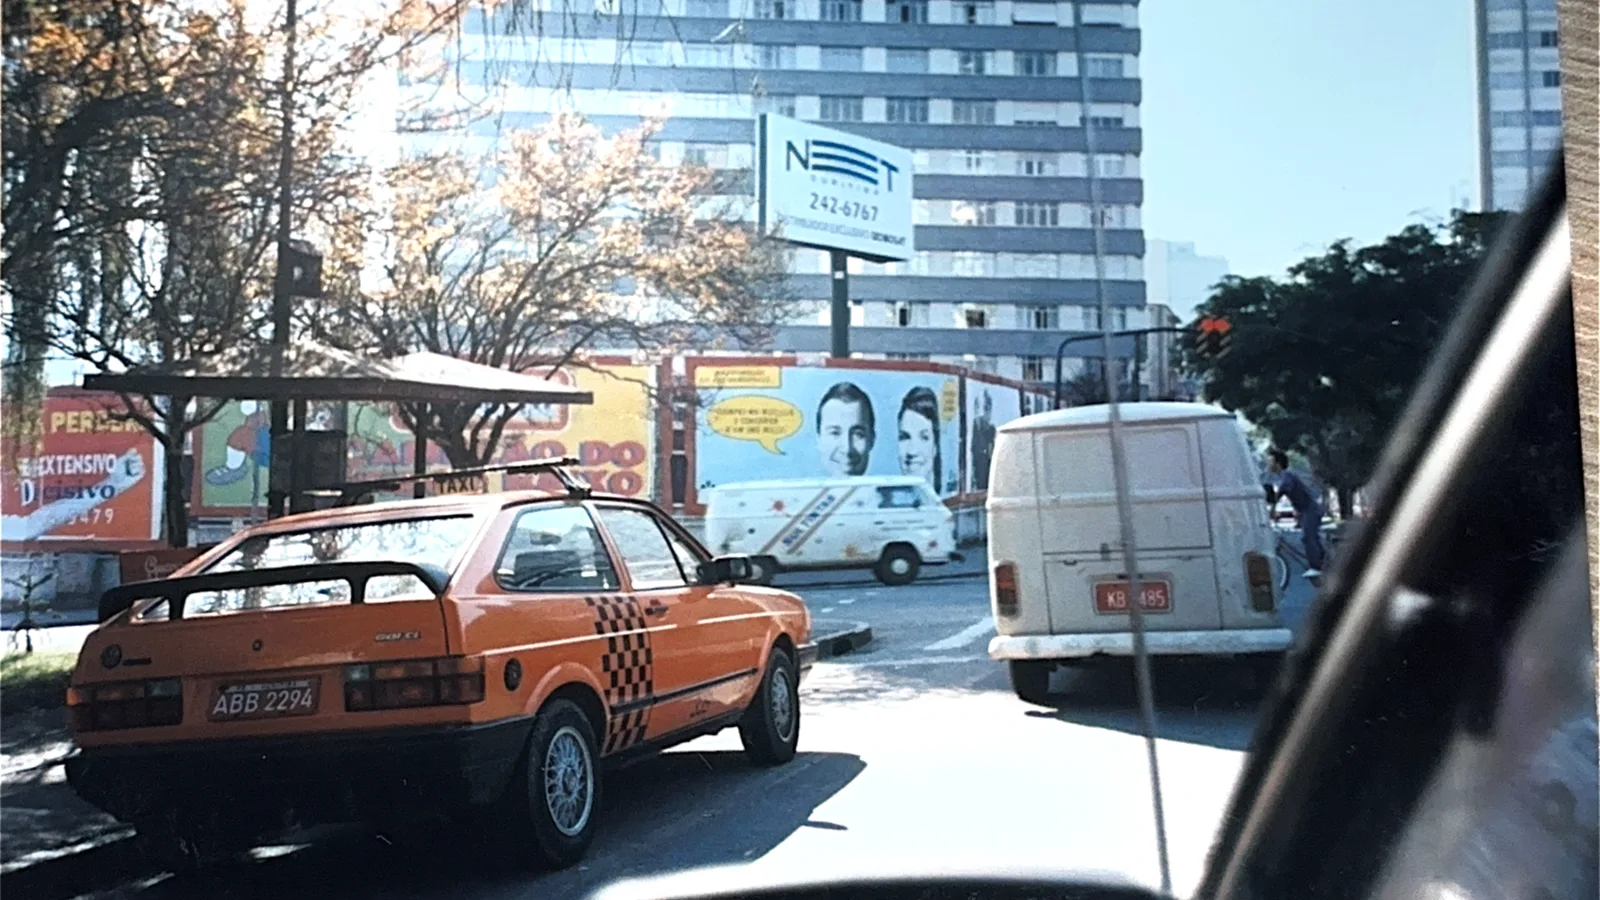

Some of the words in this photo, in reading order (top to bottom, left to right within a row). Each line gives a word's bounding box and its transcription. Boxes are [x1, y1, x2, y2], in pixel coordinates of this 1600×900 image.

[809, 192, 879, 222] 242-6767
[579, 440, 646, 468] DO
[437, 476, 475, 495] TAXI
[1107, 591, 1126, 608] KB
[1129, 589, 1166, 608] 485
[212, 692, 260, 715] ABB
[264, 687, 312, 712] 2294
